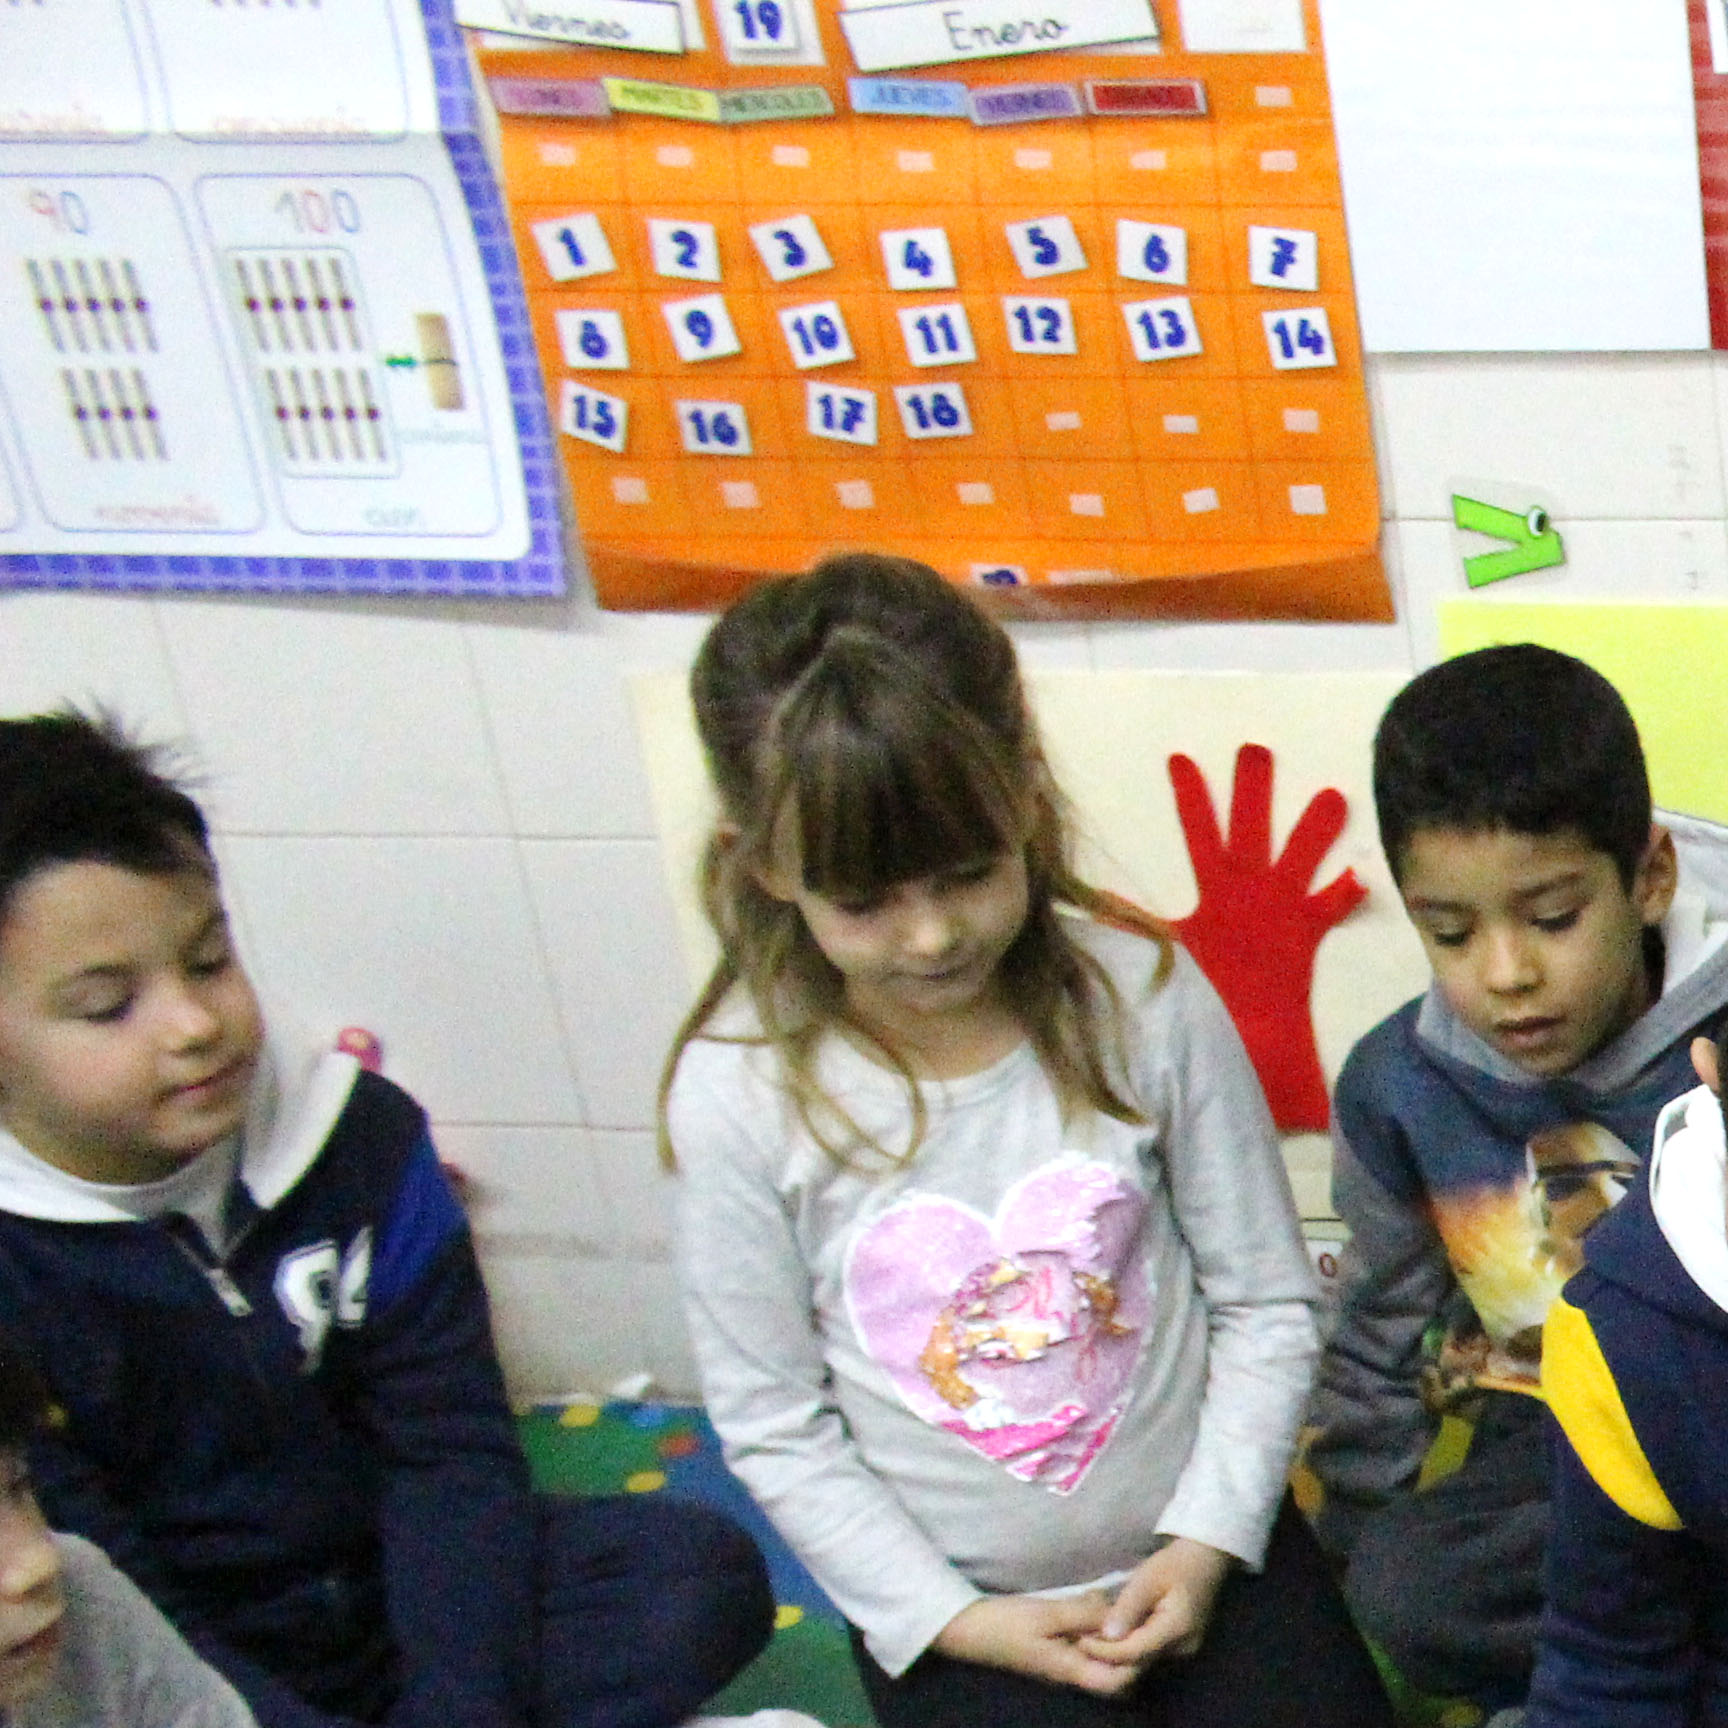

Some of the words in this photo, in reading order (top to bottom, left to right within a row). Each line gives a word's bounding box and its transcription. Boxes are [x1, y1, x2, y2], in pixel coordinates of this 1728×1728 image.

[735, 0, 783, 40] 19
[943, 9, 1070, 51] Enero
[28, 189, 90, 235] 90
[274, 189, 362, 235] 100
[559, 228, 586, 267] 1
[671, 230, 698, 269] 2
[774, 230, 806, 268] 3
[903, 240, 934, 278] 4
[1027, 227, 1059, 267] 5
[1143, 234, 1170, 274] 6
[1270, 237, 1299, 278] 7
[579, 319, 609, 361] 8
[685, 310, 714, 348] 9
[793, 315, 840, 356] 10
[914, 313, 959, 355] 11
[1014, 307, 1062, 344] 12
[1137, 309, 1186, 351] 13
[1273, 319, 1324, 359] 14
[573, 394, 617, 439] 15
[687, 409, 739, 446] 16
[816, 394, 867, 435] 17
[906, 392, 961, 431] 18
